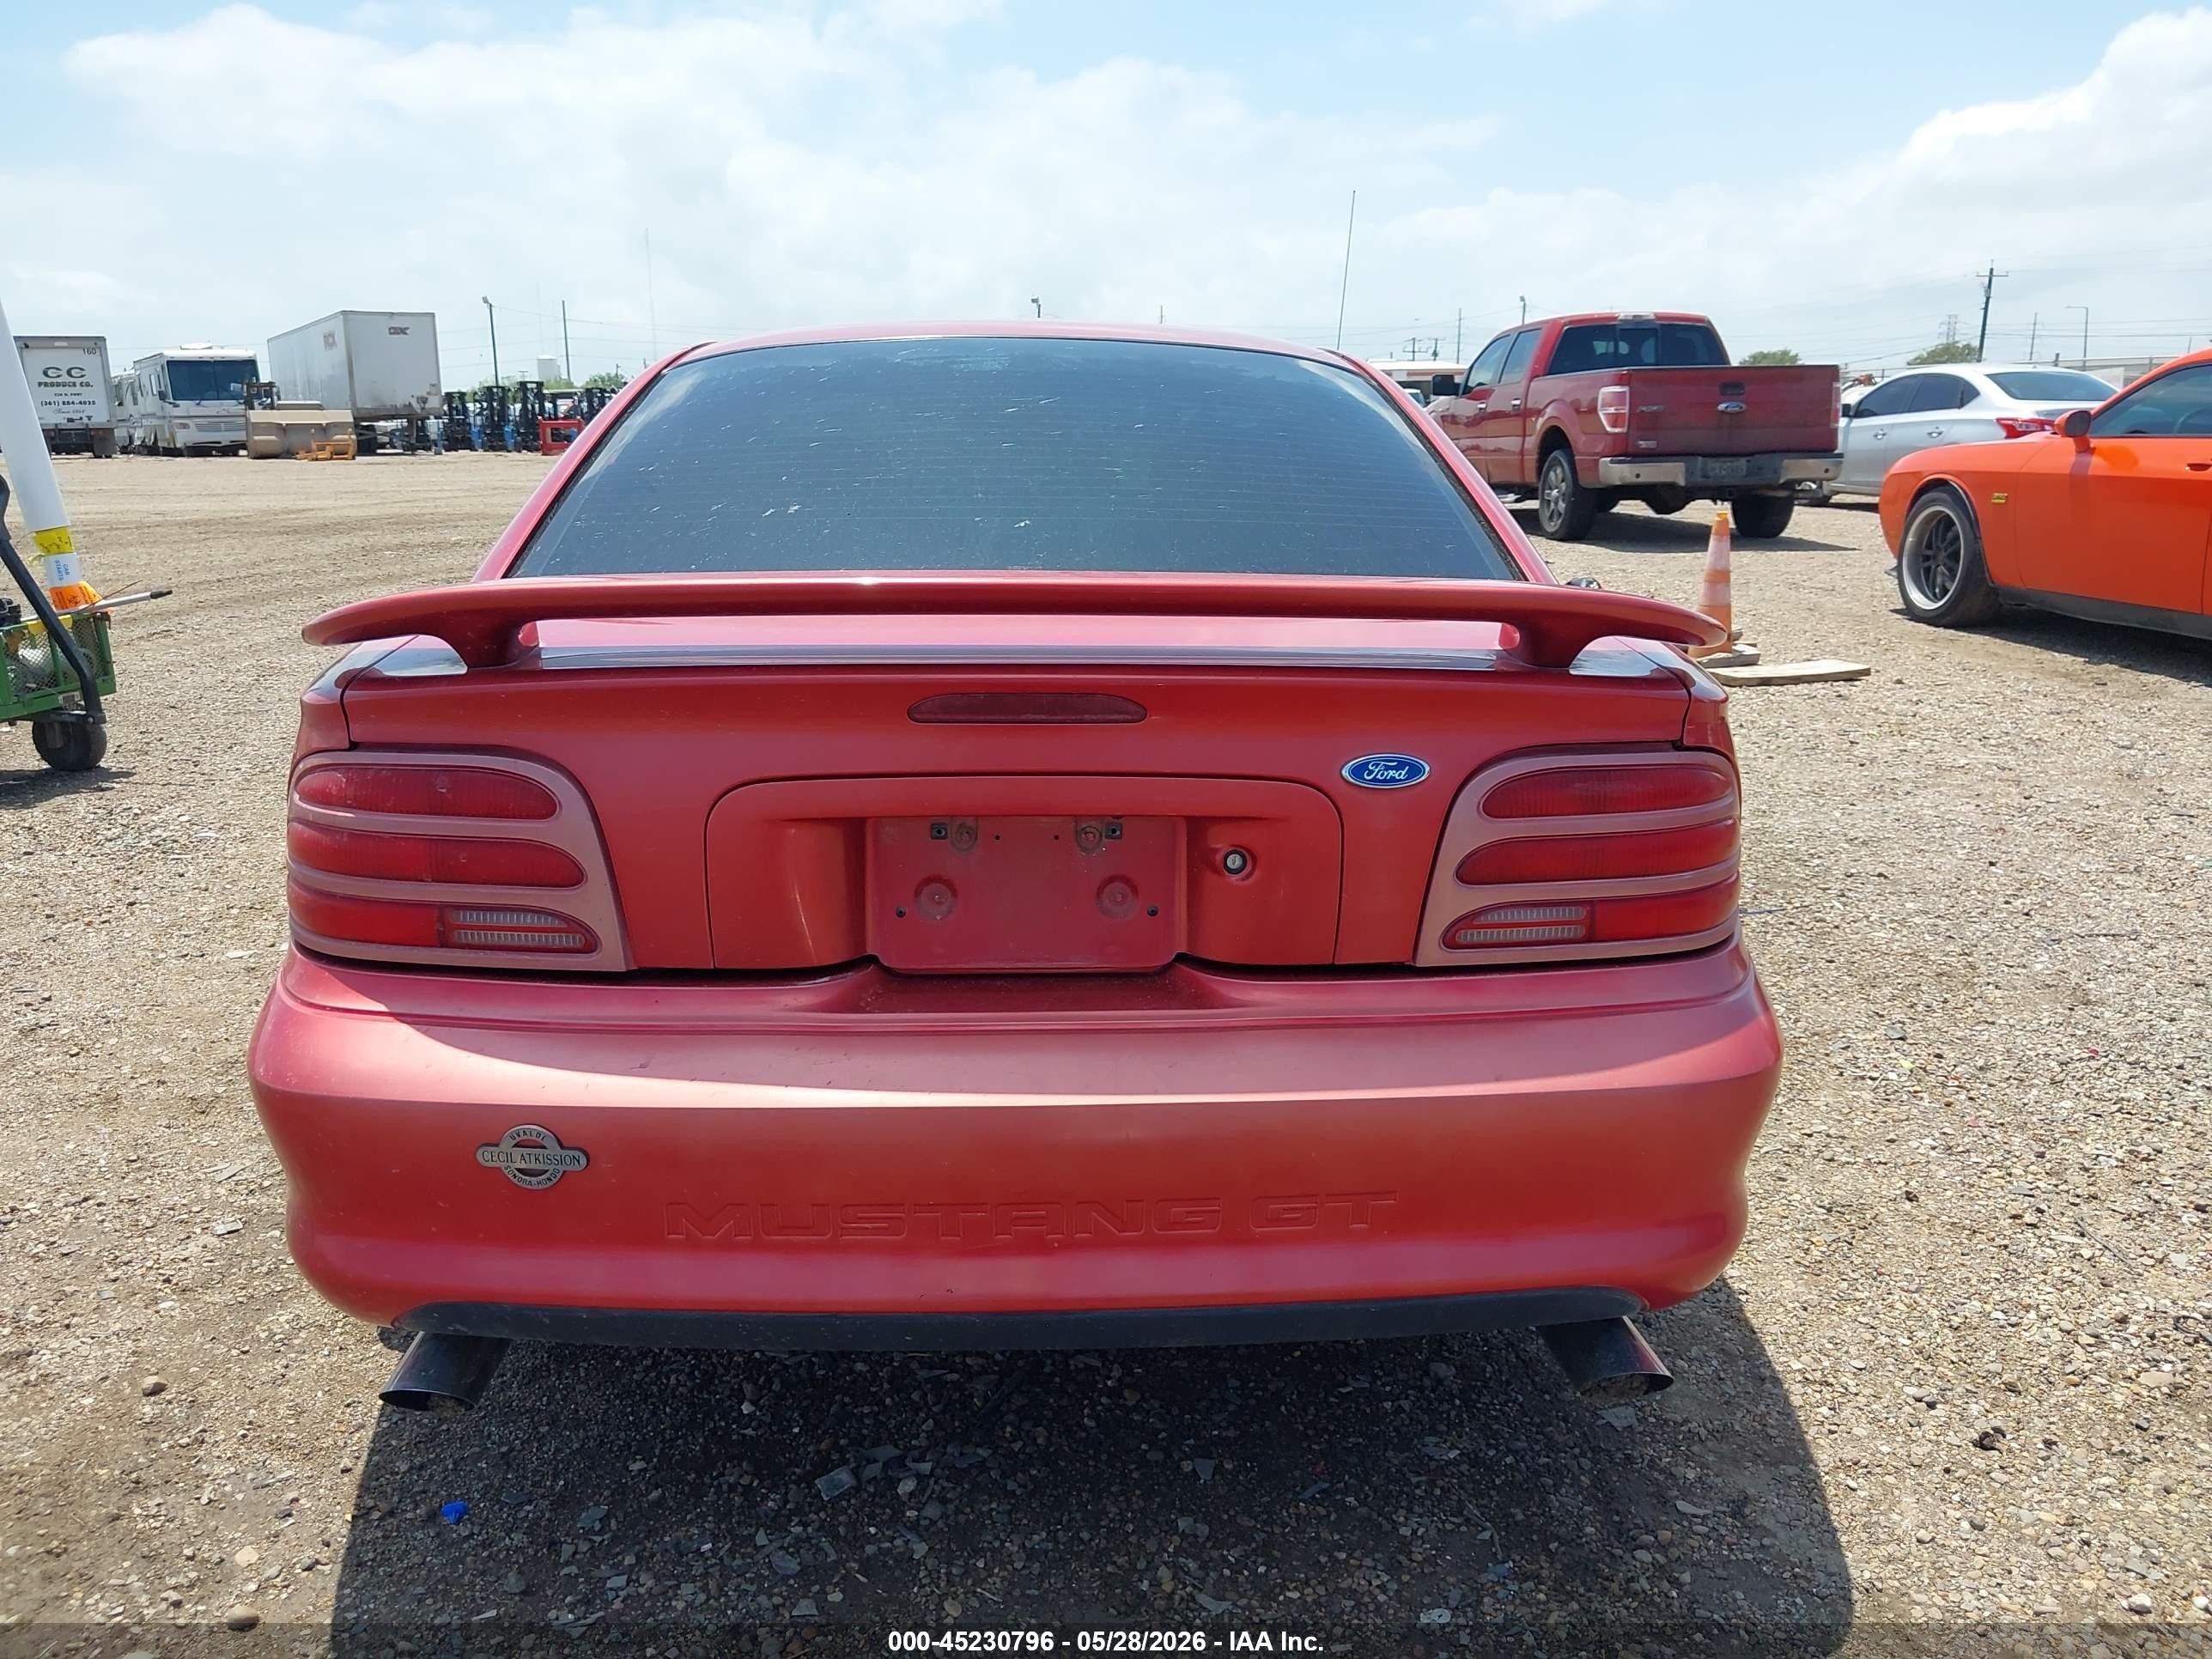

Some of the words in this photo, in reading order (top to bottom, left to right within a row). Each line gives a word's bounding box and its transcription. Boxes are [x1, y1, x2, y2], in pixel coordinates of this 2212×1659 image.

[1364, 762, 1409, 780] Ford
[482, 1151, 517, 1164] CECIL
[520, 1152, 580, 1166] ATKISSION
[665, 1197, 1222, 1239] MUSTANG
[1250, 1191, 1397, 1231] GT
